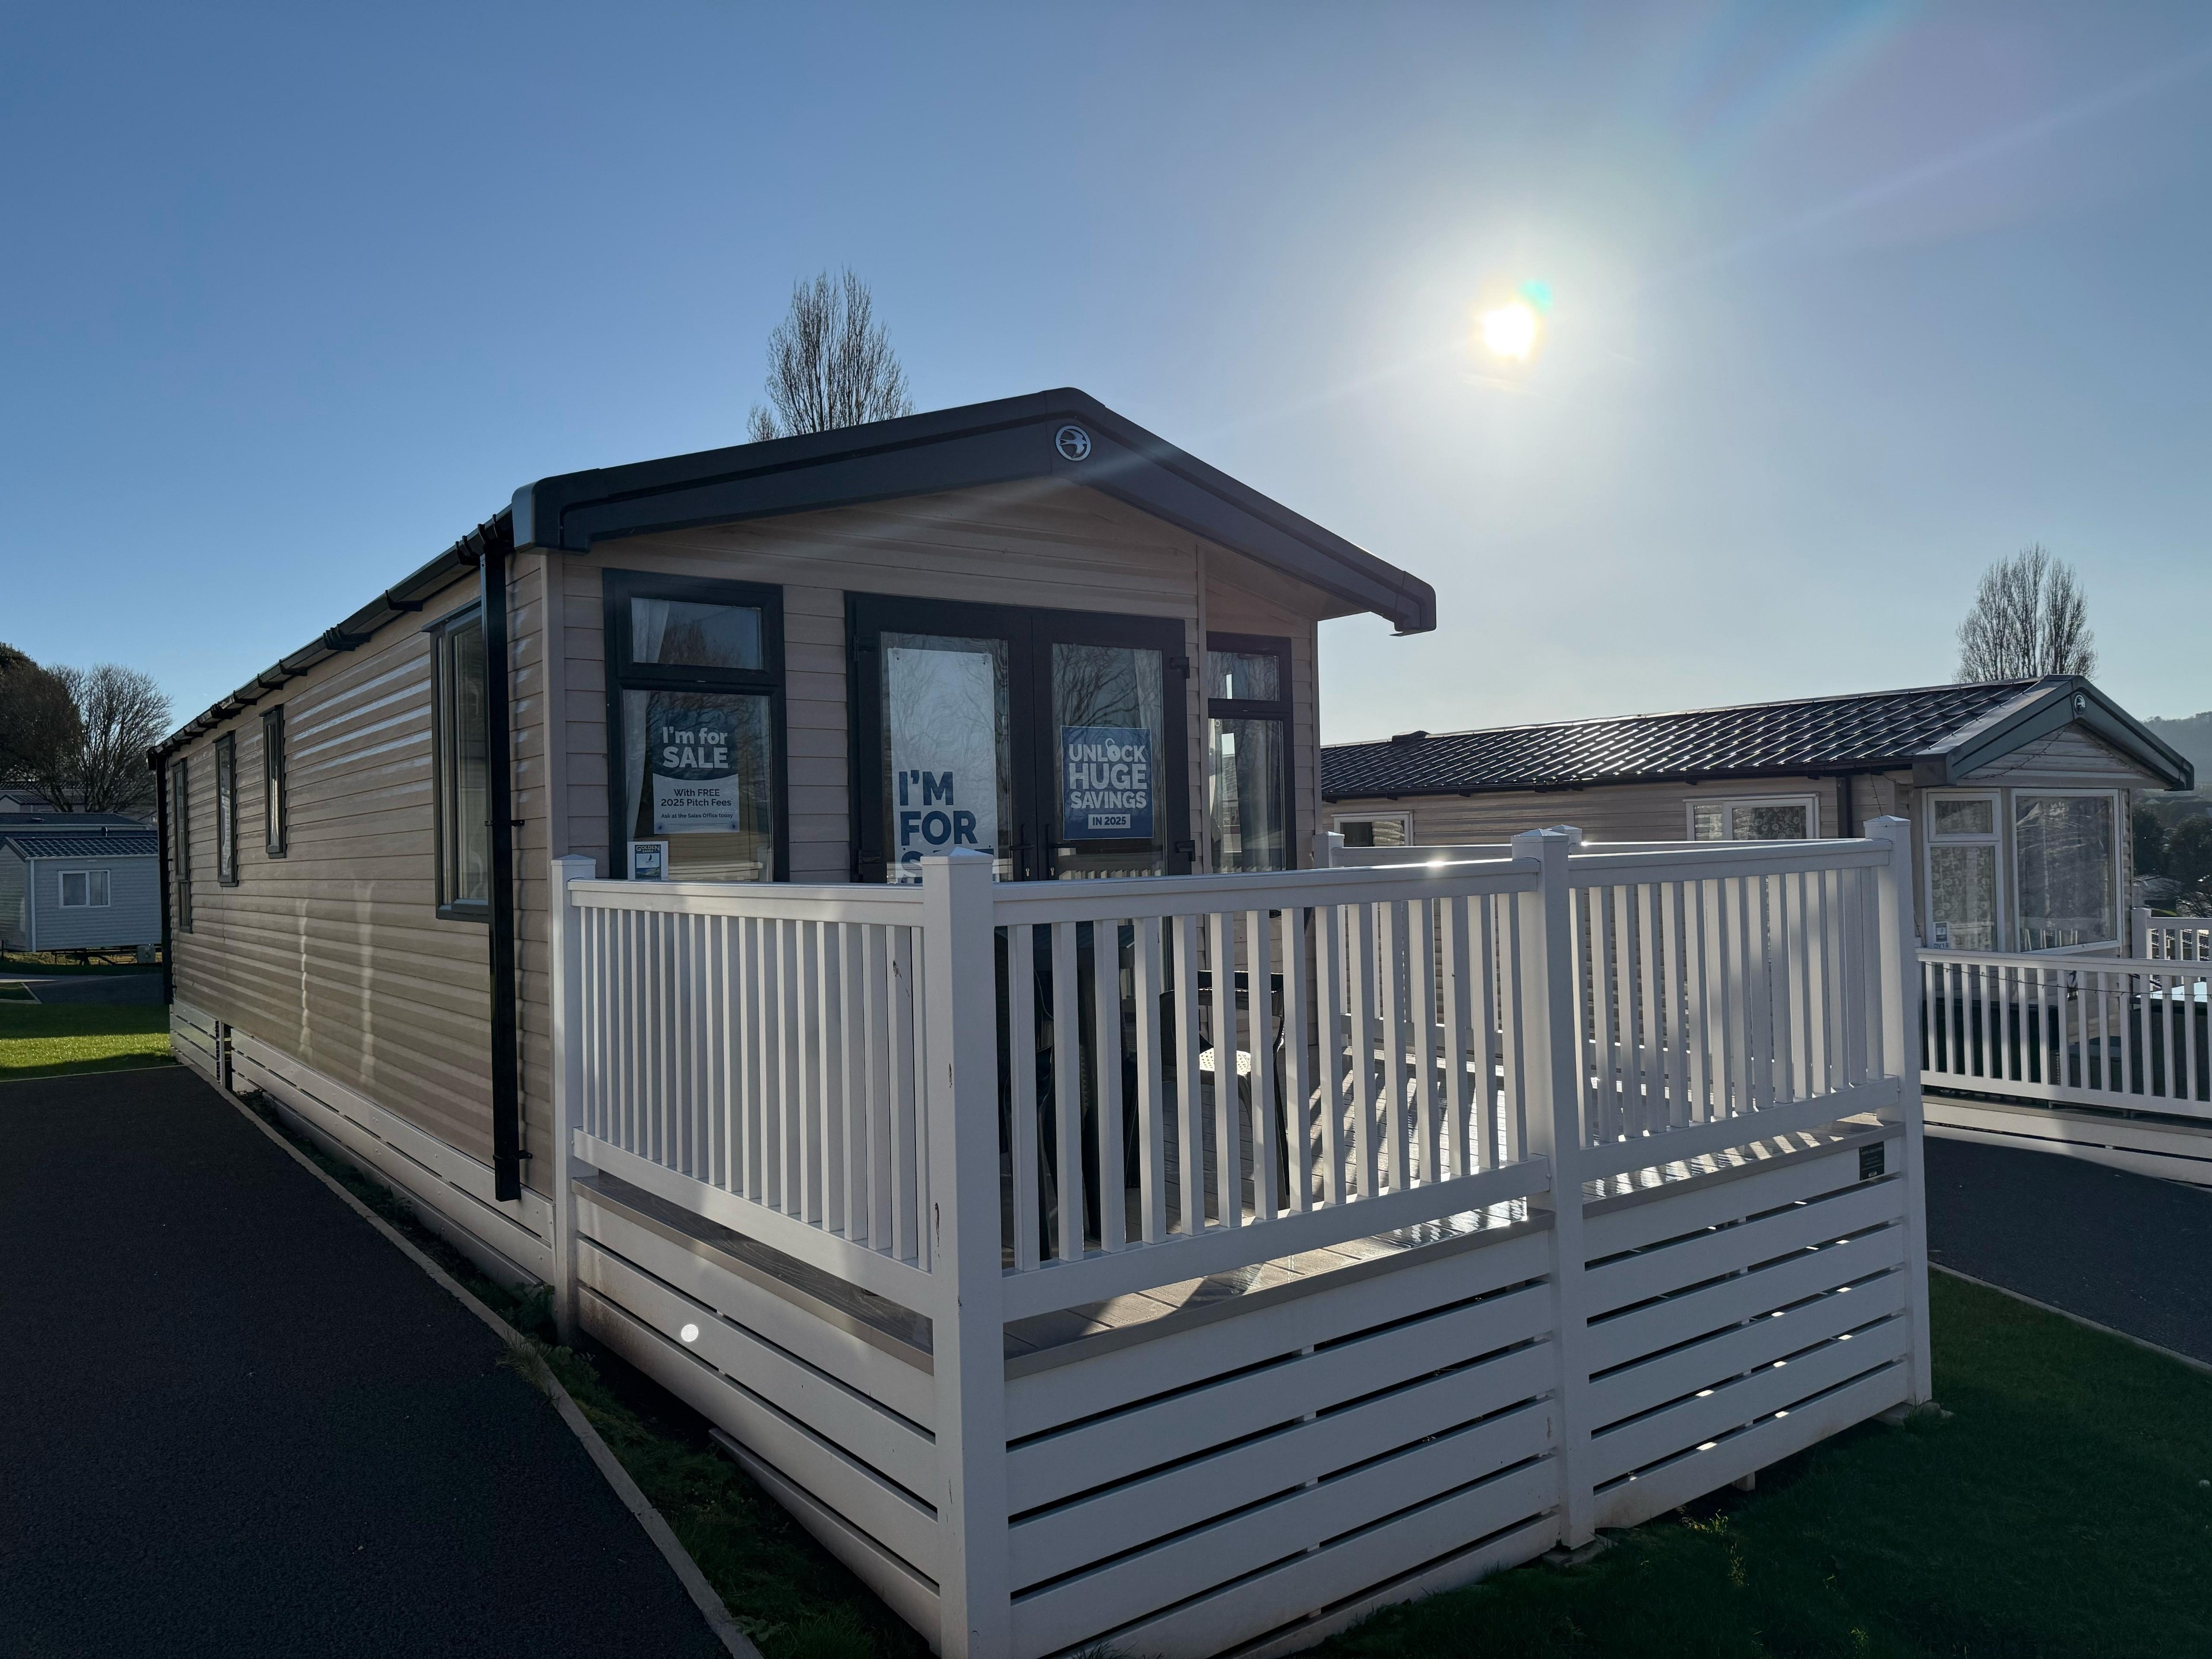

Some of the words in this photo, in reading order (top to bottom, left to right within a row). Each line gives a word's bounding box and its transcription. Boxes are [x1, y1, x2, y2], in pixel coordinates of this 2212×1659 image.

[662, 726, 695, 744] I'm
[699, 728, 728, 745] for
[662, 746, 729, 768] SALE
[1069, 743, 1146, 763] UNLOCK
[1069, 763, 1147, 790] HUGE
[673, 789, 695, 797] With
[698, 789, 720, 797] FREE
[899, 770, 954, 806] I'M
[687, 798, 709, 806] Pitch
[1070, 791, 1147, 809] SAVINGS
[900, 810, 978, 846] FOR
[1092, 816, 1102, 826] IN
[1104, 816, 1126, 825] 2025
